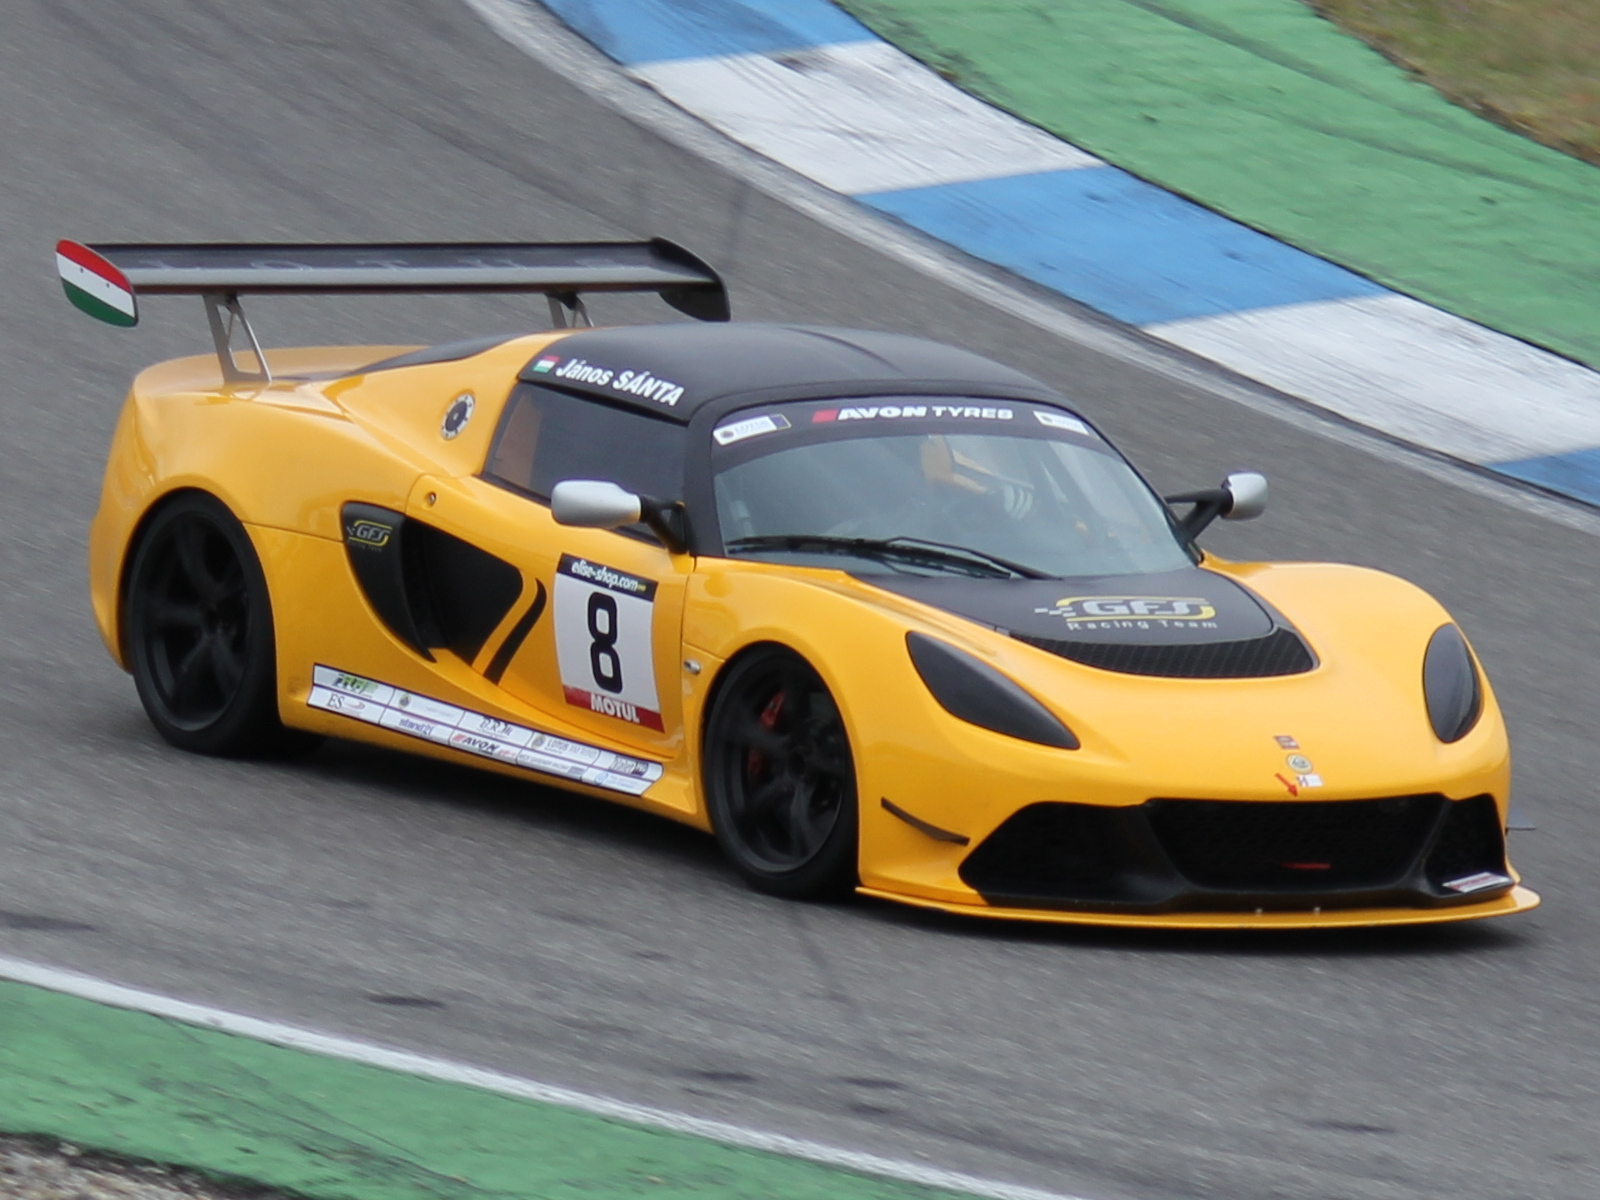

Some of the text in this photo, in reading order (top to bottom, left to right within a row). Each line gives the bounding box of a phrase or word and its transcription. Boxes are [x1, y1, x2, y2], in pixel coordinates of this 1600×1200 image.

[555, 357, 685, 407] János SÁNTA
[837, 405, 1013, 421] AVON TYRES
[571, 559, 639, 592] elise-shop.com
[1067, 619, 1218, 631] Racing Team
[587, 591, 623, 694] 8
[590, 692, 640, 723] MOTUL
[463, 736, 500, 752] AVON
